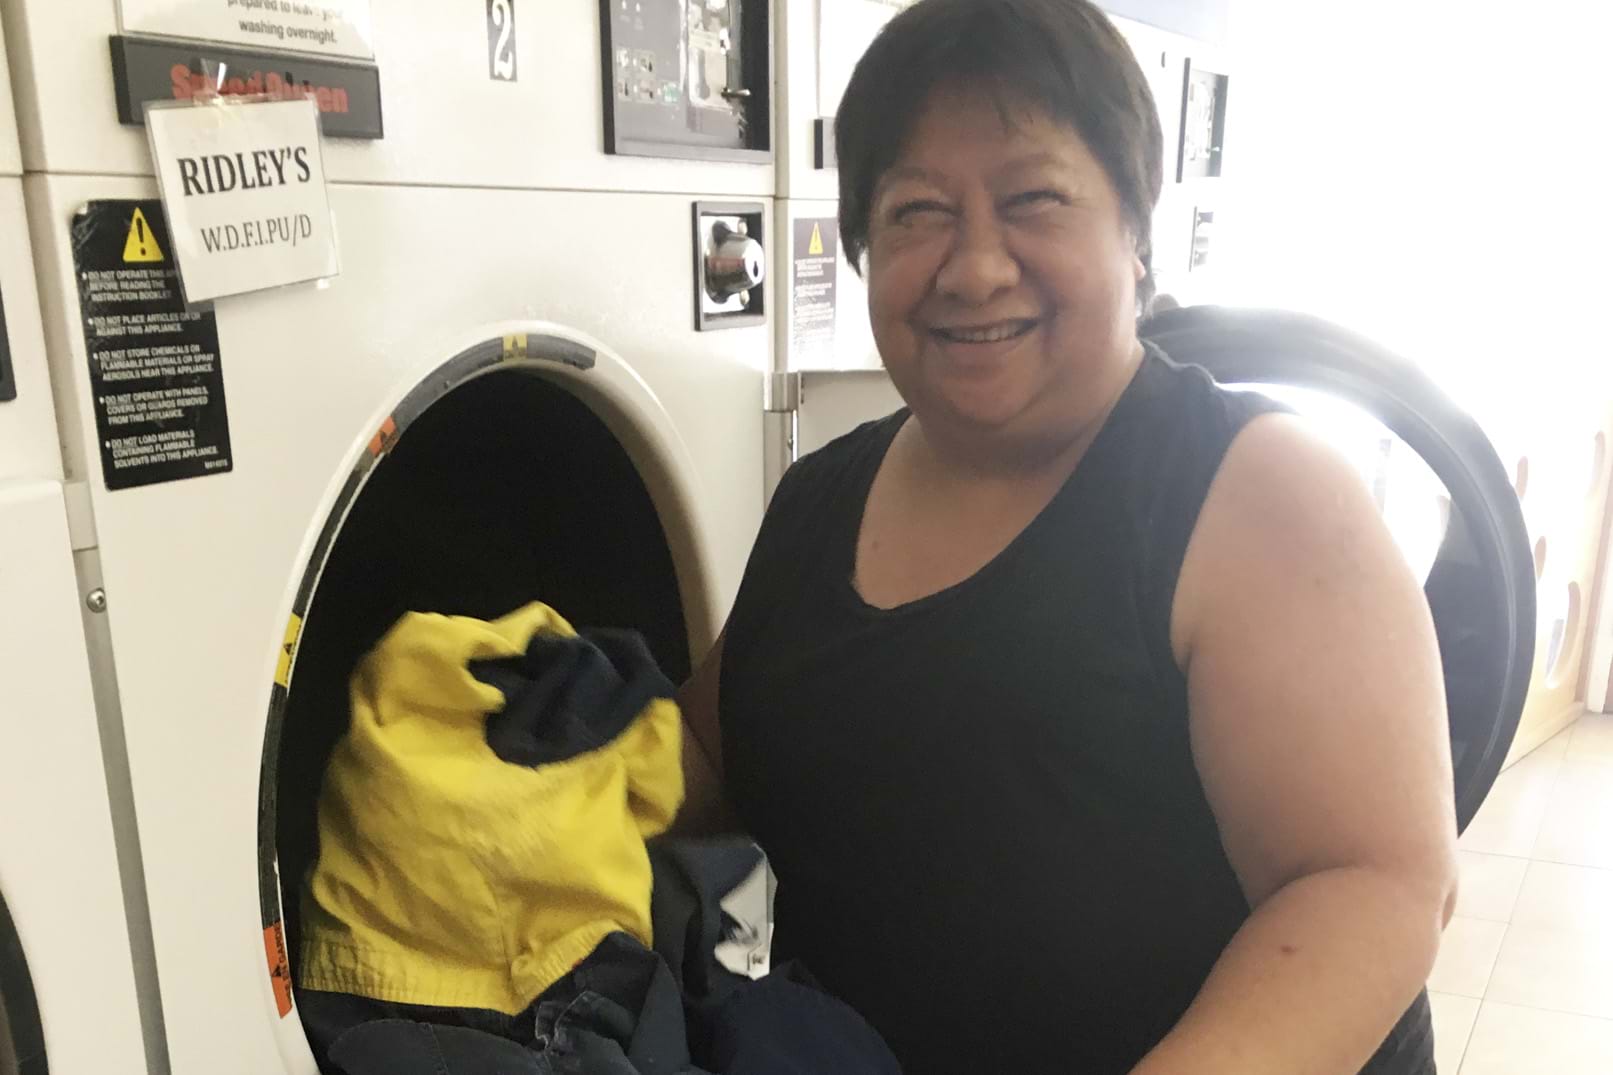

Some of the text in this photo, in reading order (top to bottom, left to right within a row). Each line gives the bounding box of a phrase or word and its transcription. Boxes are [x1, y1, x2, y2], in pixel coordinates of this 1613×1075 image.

[238, 19, 338, 45] washing overnight.
[491, 0, 513, 80] 2
[176, 146, 311, 197] RIDLEY'S
[88, 271, 99, 280] DO
[100, 270, 115, 279] NOT
[116, 270, 148, 279] OPERATE
[120, 280, 151, 290] READING
[152, 280, 164, 288] THE
[91, 291, 138, 301] INSTRUCTION
[94, 316, 105, 326] DO
[106, 316, 120, 326] NOT
[122, 314, 145, 324] PLACE
[147, 313, 178, 323] ARTICLES
[96, 326, 126, 336] AGAINST
[127, 326, 143, 334] THIS
[99, 351, 110, 360] DO
[111, 350, 125, 360] NOT
[127, 348, 150, 358] STORE
[151, 345, 189, 356] CHEMICALS
[101, 353, 214, 371] FLAMMABLE MATERIALS OR SPRAY
[103, 370, 140, 381] AEROSOLS
[141, 369, 160, 378] NEAR
[161, 367, 176, 375] THIS
[105, 395, 116, 404] DO
[117, 394, 131, 403] NOT
[133, 390, 164, 401] OPERATE
[165, 389, 181, 398] WITH
[107, 396, 208, 415] COVERS OR GUARDS REMOVED
[108, 415, 128, 426] FROM
[129, 413, 144, 422] THIS
[111, 429, 195, 448] DO NOT LOAD MATERIALS
[113, 439, 195, 458] CONTAINING FLAMMABLE
[114, 446, 218, 469] SOLVENTS INTO THIS APPLIANCE.
